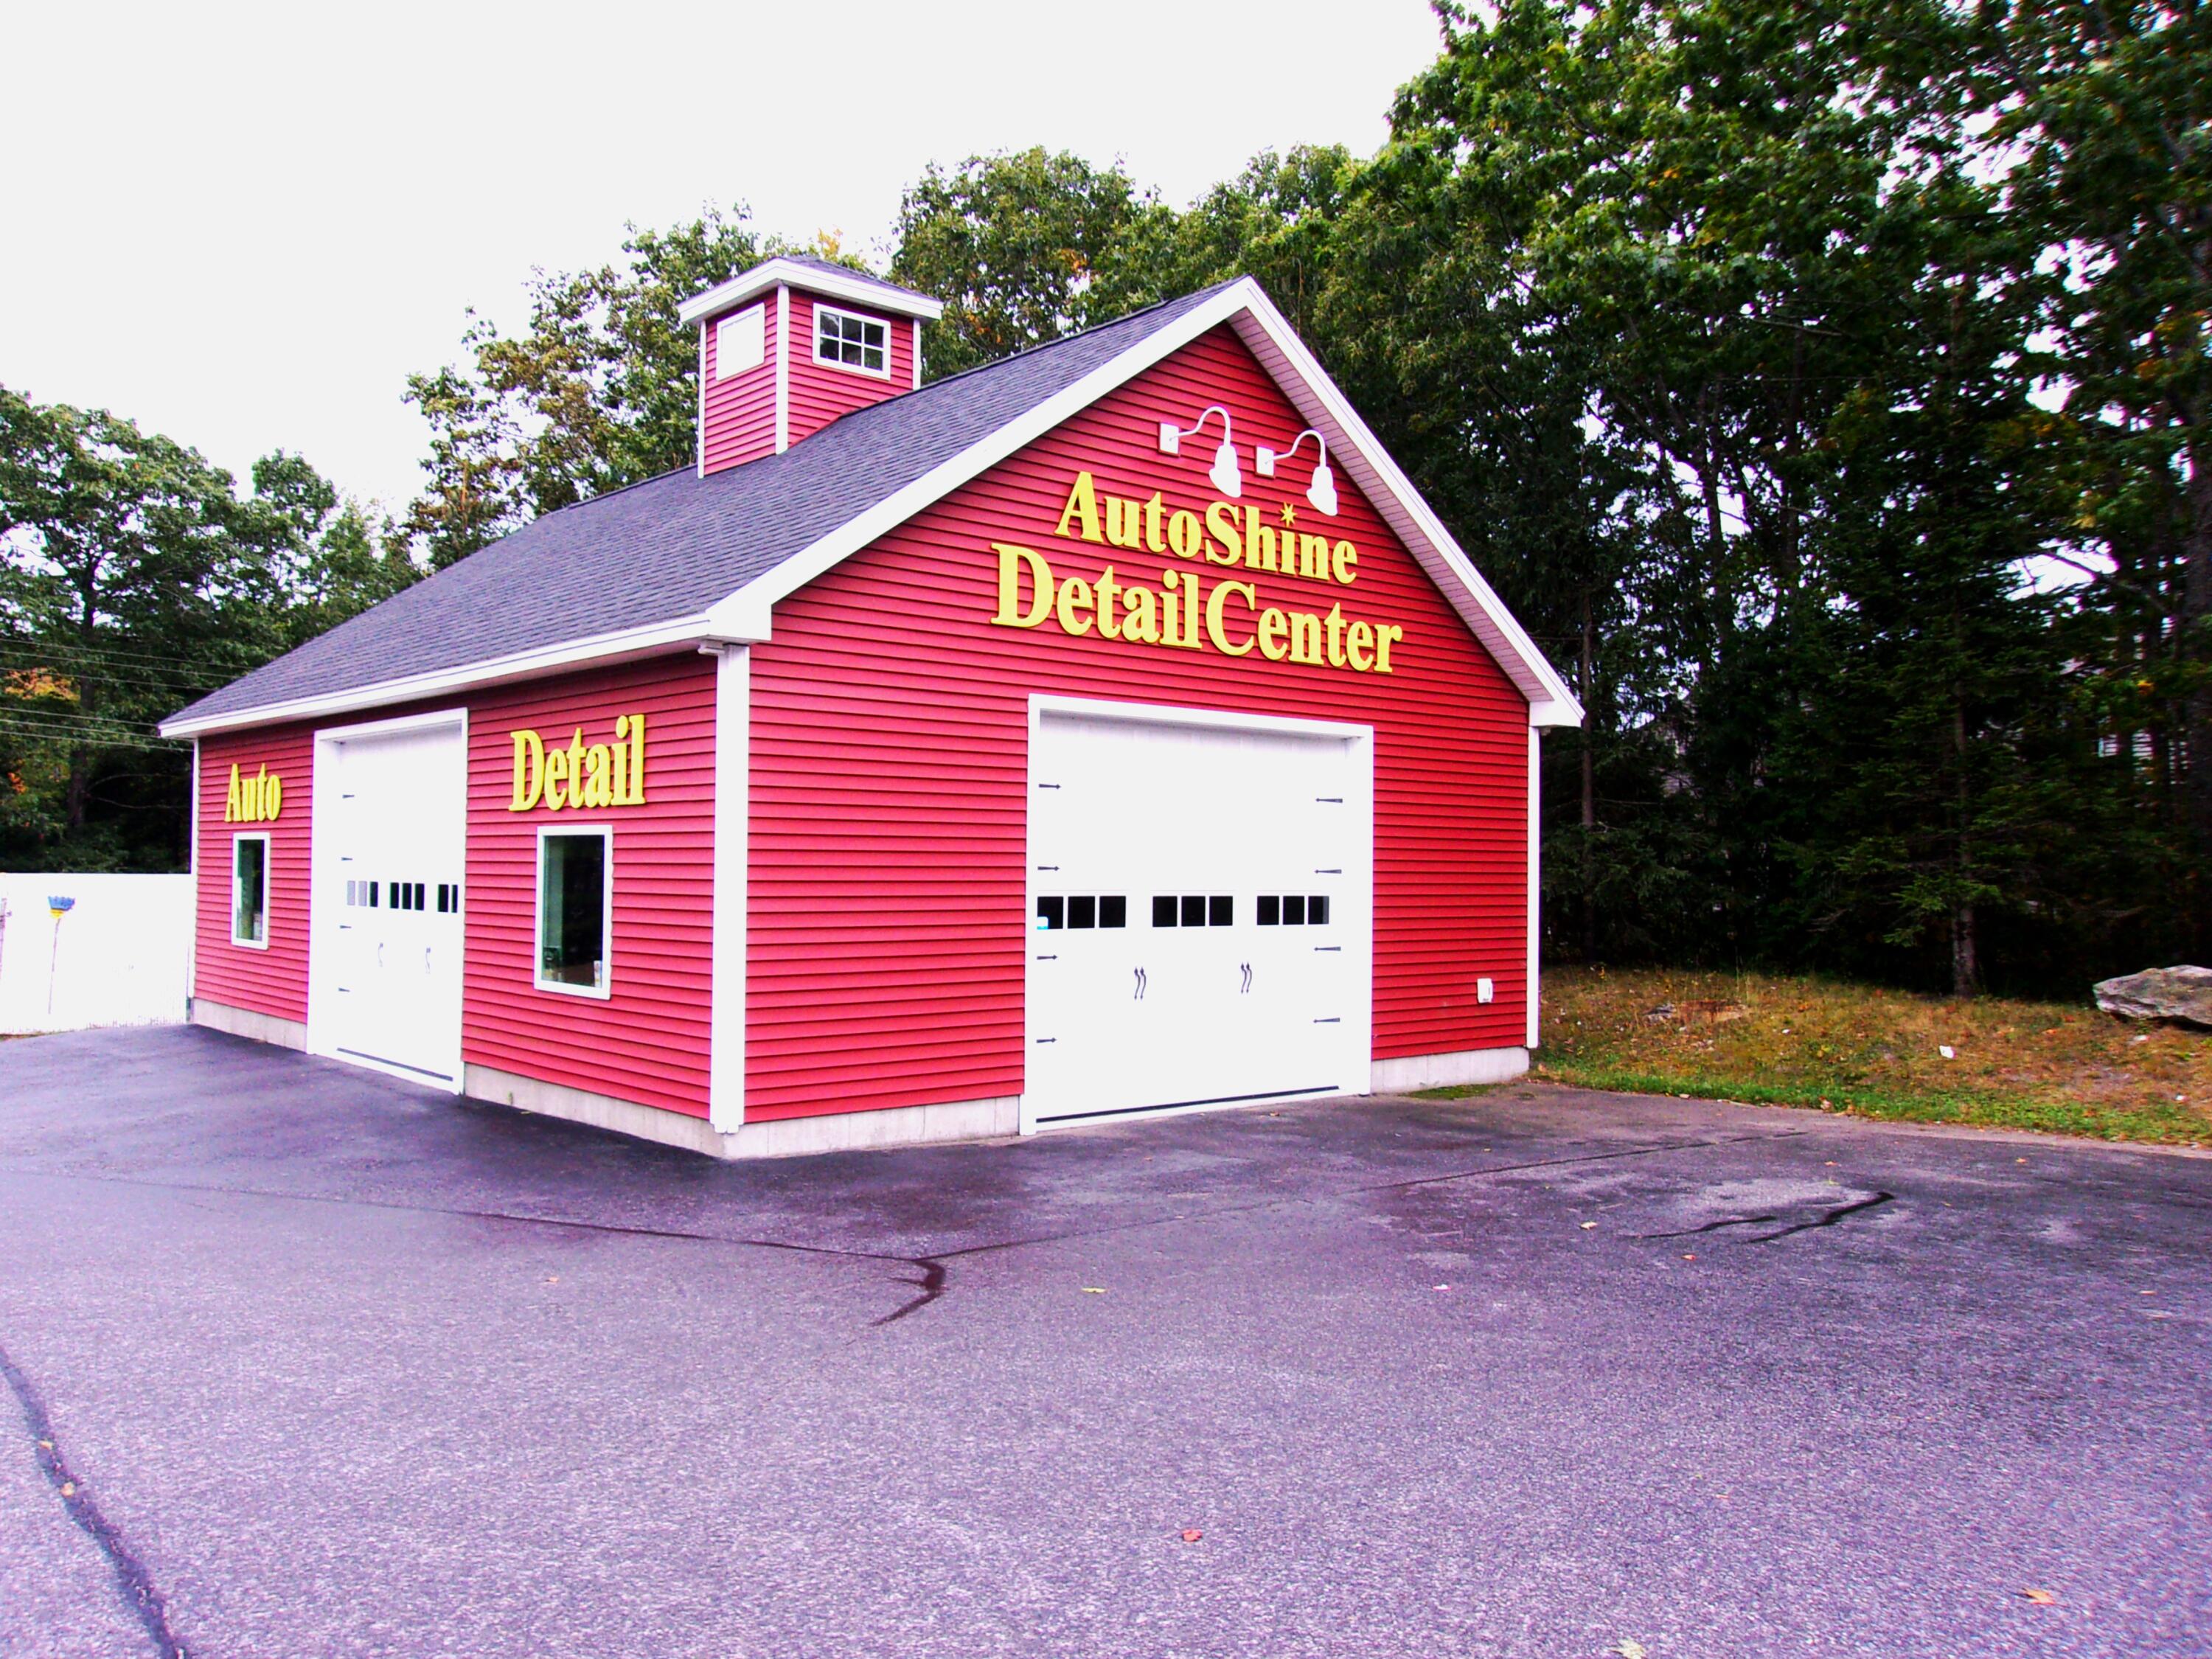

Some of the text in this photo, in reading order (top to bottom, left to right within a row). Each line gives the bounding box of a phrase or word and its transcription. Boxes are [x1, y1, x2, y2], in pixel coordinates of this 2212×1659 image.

[1055, 470, 1358, 585] AutoShine
[224, 763, 282, 822] Auto
[509, 714, 646, 811] Detail
